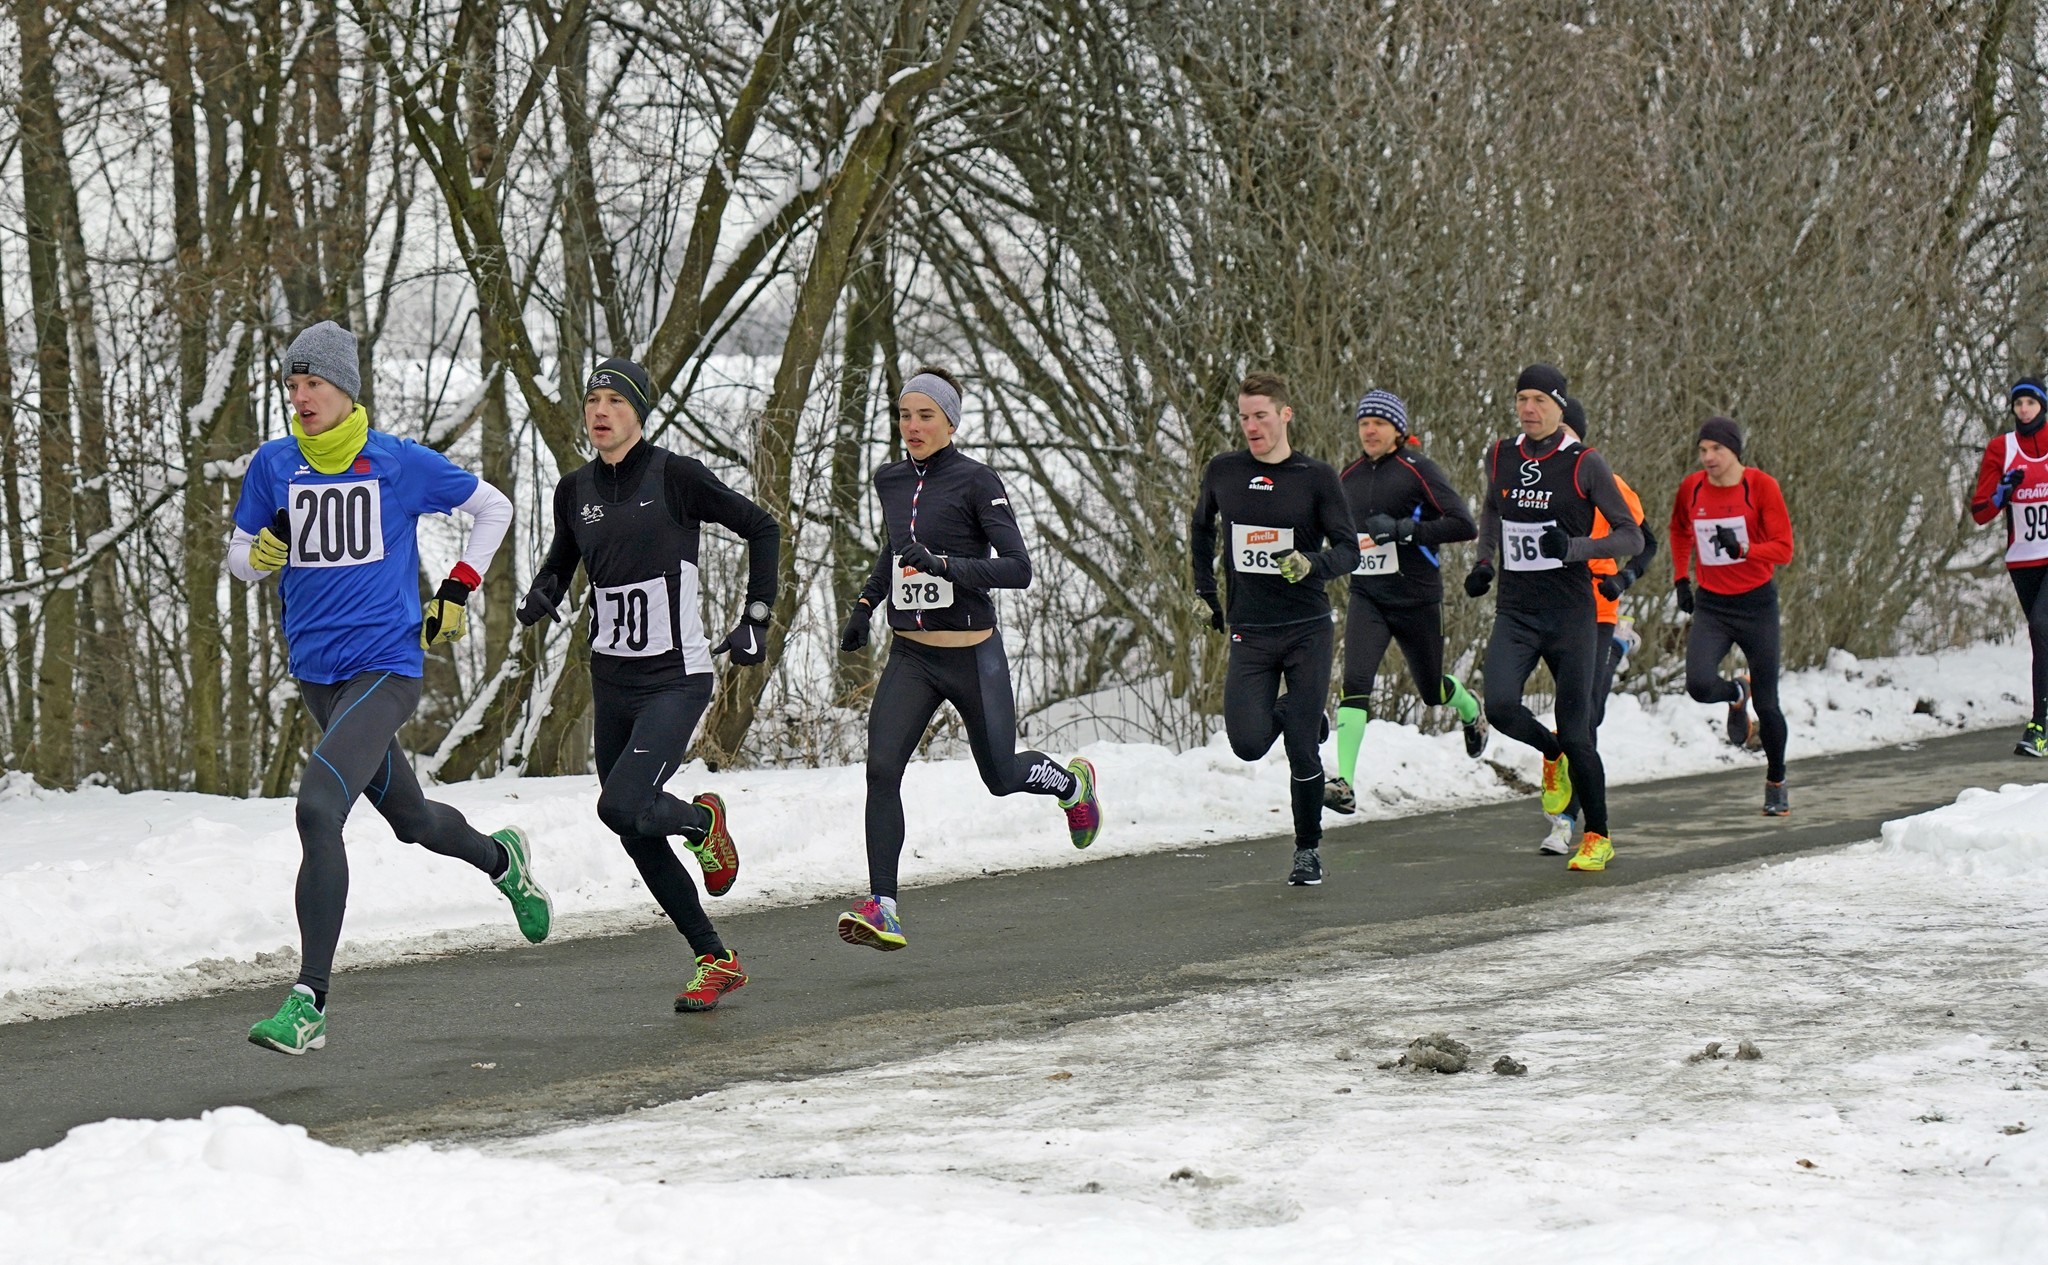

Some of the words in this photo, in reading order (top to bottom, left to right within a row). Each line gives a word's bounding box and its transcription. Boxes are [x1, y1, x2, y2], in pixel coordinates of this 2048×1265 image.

[1248, 483, 1274, 491] skinfit
[1511, 488, 1553, 501] SPORT
[295, 486, 373, 562] 200
[2024, 504, 2048, 542] 99
[1250, 531, 1275, 543] rivella
[1508, 535, 1538, 562] 36
[901, 582, 940, 604] 378
[605, 588, 649, 651] 70
